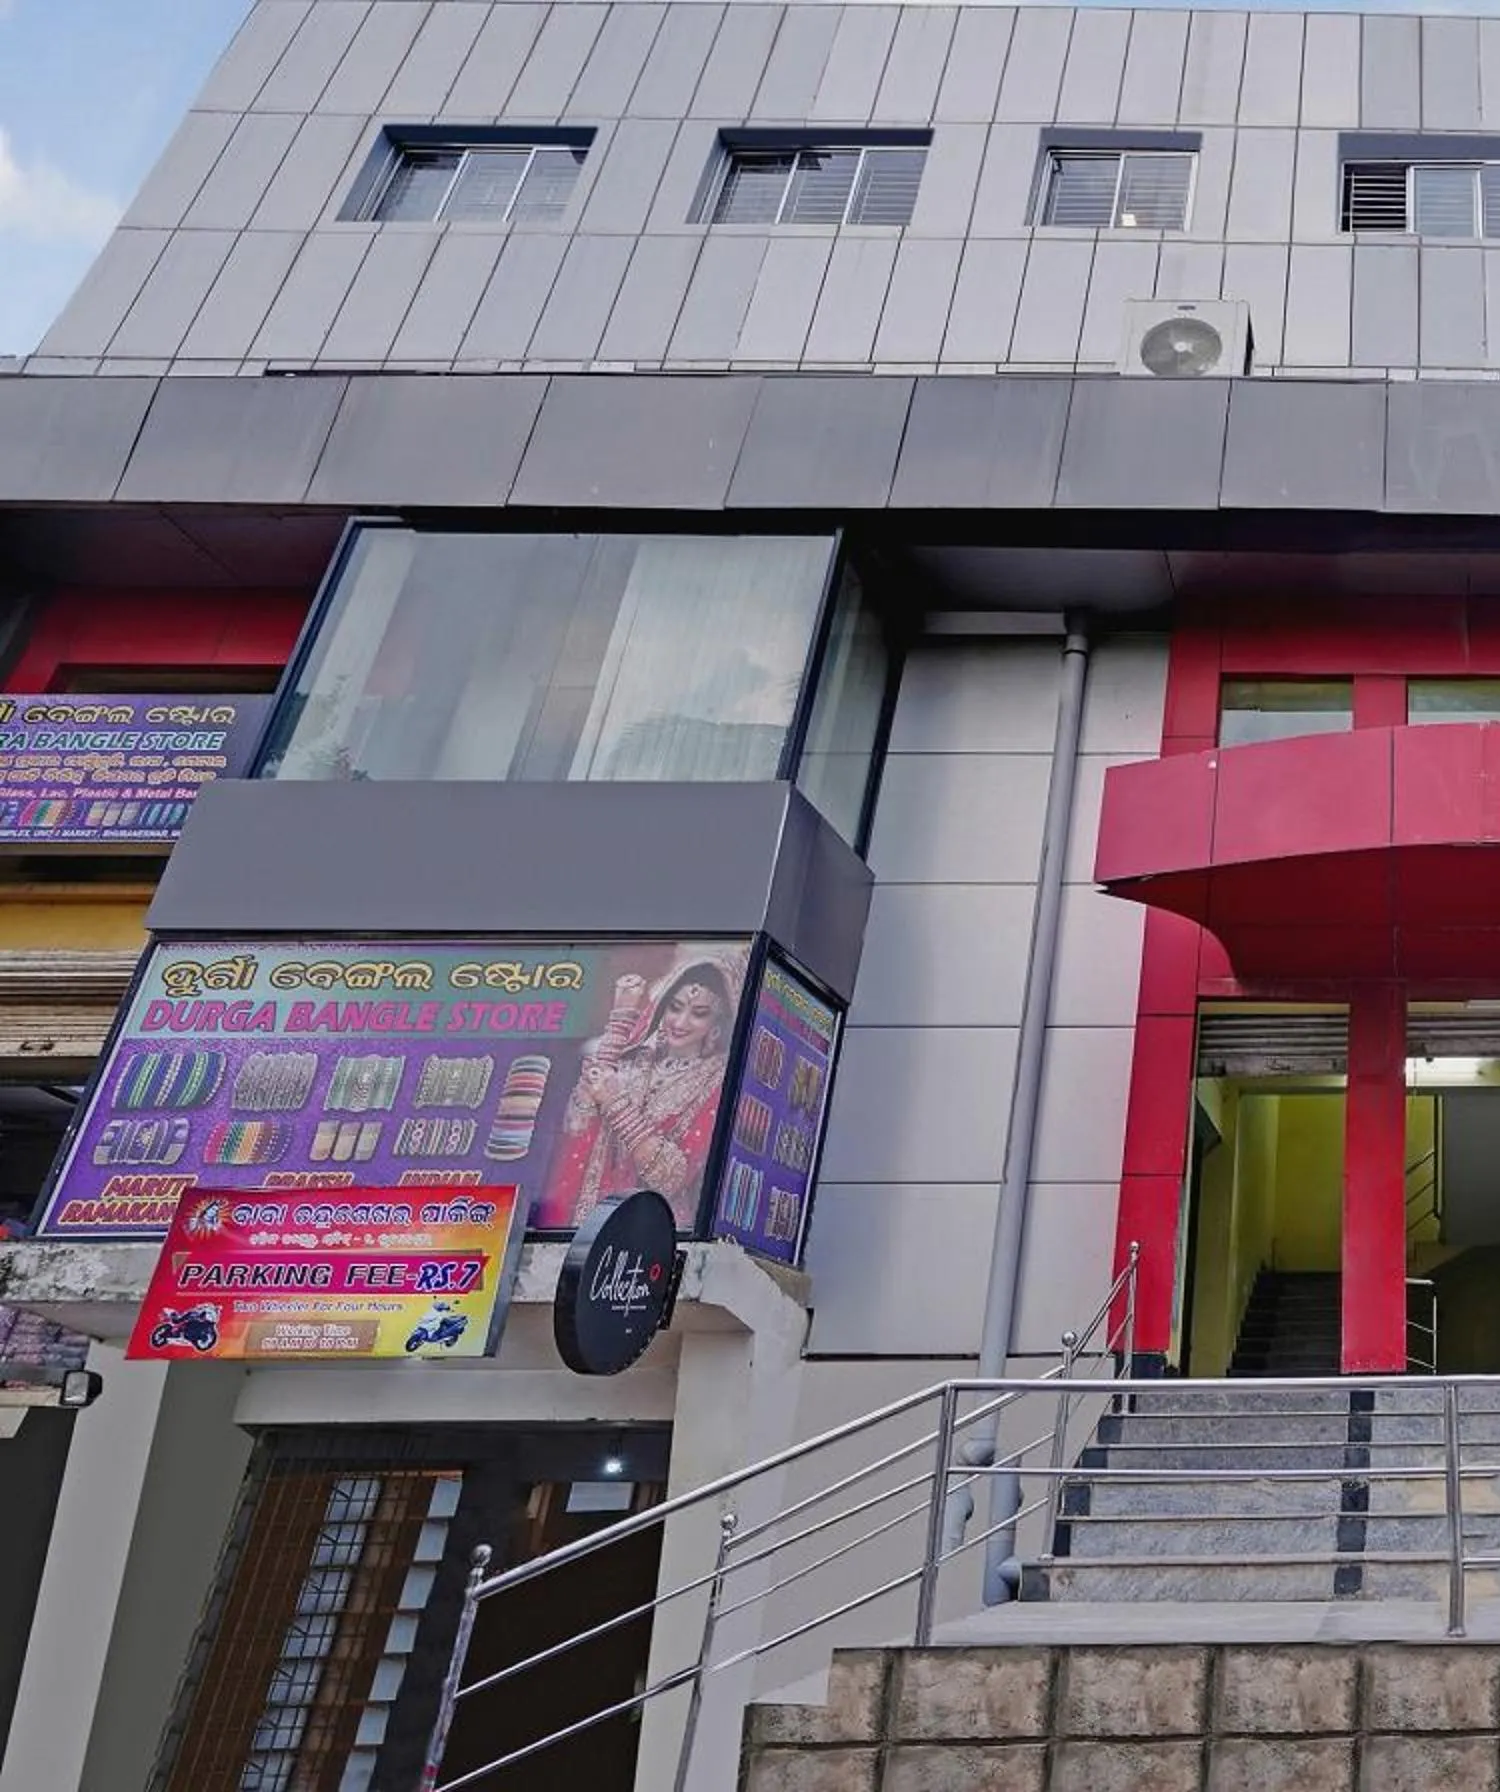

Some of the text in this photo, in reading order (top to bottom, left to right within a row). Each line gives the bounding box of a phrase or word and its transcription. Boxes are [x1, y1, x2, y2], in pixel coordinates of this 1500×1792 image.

[32, 731, 141, 750] BANGLE
[140, 731, 226, 750] STORE
[140, 1000, 568, 1032] DURGA BANGLE STORE
[178, 1263, 332, 1288] PARKING
[589, 1245, 650, 1317] Collection
[260, 1300, 310, 1313] Wheeler
[313, 1301, 334, 1312] For
[335, 1301, 365, 1312] Four
[367, 1301, 403, 1312] Hours
